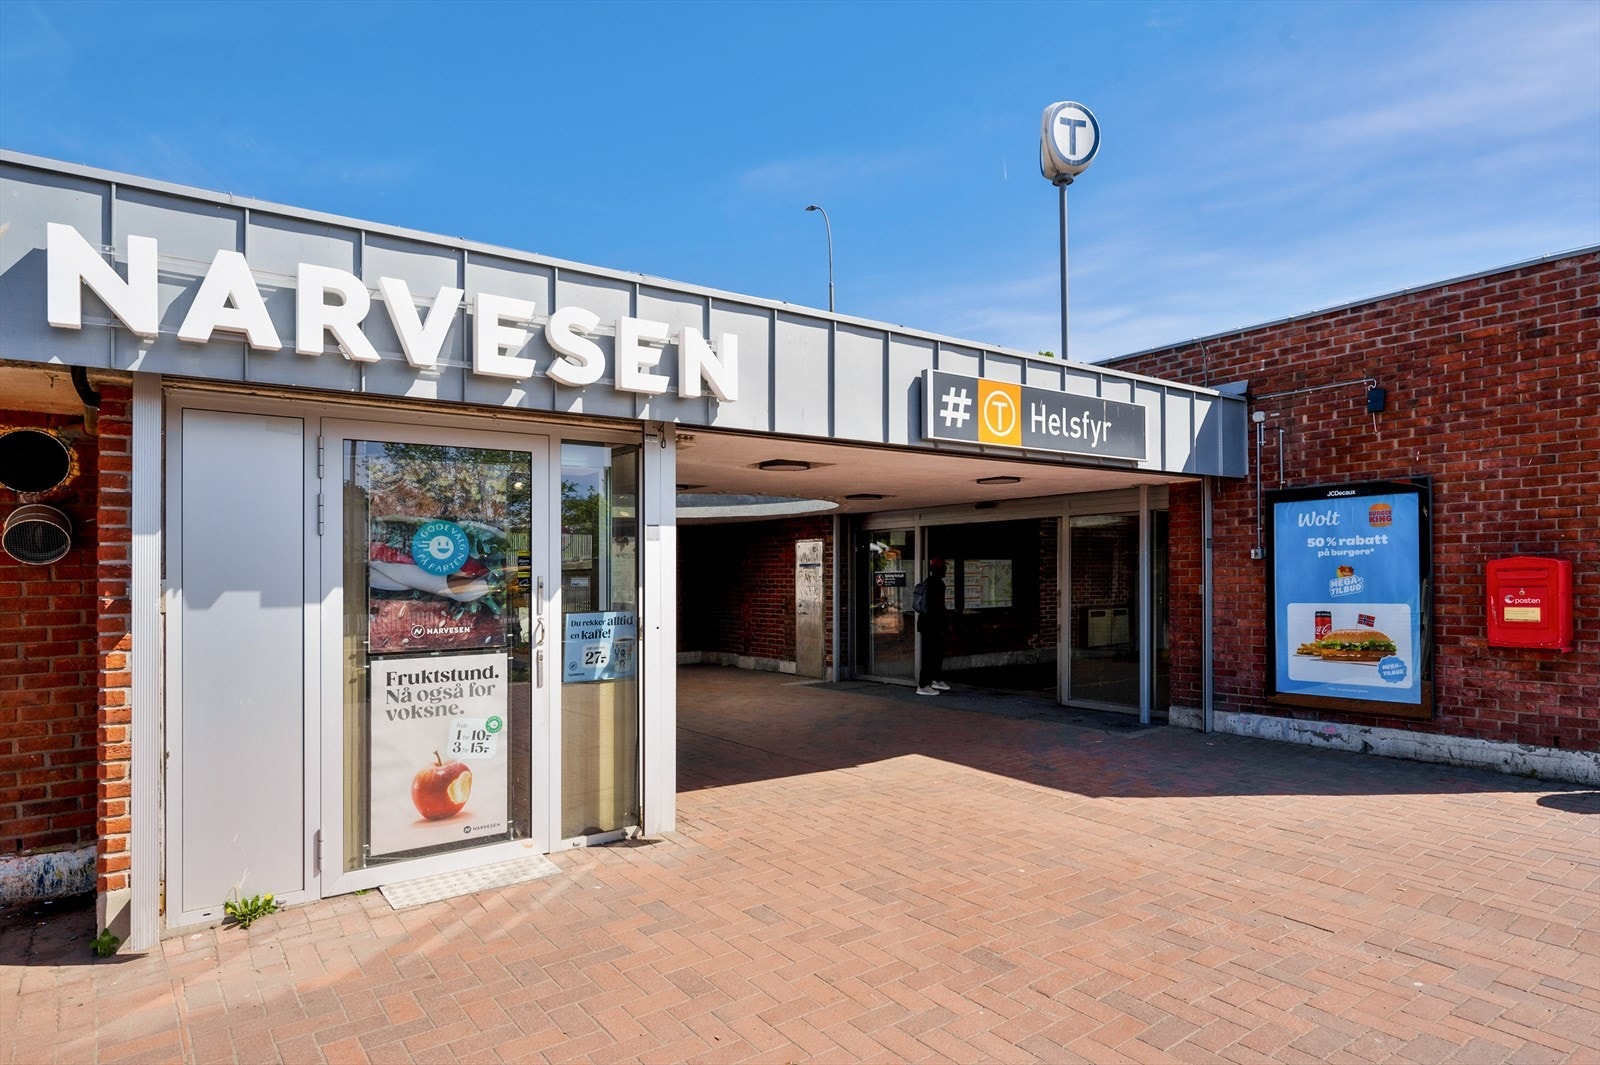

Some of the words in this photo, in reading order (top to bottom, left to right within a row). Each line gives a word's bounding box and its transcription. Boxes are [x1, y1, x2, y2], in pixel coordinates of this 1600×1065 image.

[1059, 116, 1087, 156] T
[46, 222, 739, 403] NARVESEN
[1030, 401, 1113, 448] Helsfyr
[1327, 489, 1356, 497] JCDecaux
[1298, 510, 1341, 528] Wolt
[1368, 509, 1392, 517] BURGER
[1368, 515, 1393, 523] KING
[420, 523, 449, 538] GODE
[451, 528, 469, 552] VALG
[1307, 536, 1325, 548] 50
[1326, 536, 1337, 547] %
[1338, 534, 1389, 546] rabatt
[1317, 548, 1330, 558] på
[417, 553, 428, 566] PÅ
[428, 553, 465, 573] FARTEN
[1330, 576, 1362, 589] MEGA-
[1331, 584, 1362, 596] TILBUD
[570, 619, 581, 627] Du
[582, 618, 607, 627] rekker
[607, 615, 633, 626] alltid
[426, 626, 471, 635] NARVESEN
[581, 628, 611, 640] kaffe!
[385, 664, 500, 687] Fruktstund.
[385, 688, 412, 705] Nå
[416, 683, 464, 704] også
[468, 682, 496, 698] for
[385, 703, 465, 721] voksne.
[456, 729, 462, 741] 1
[452, 741, 462, 753] 3
[472, 822, 501, 832] NARVESEN
